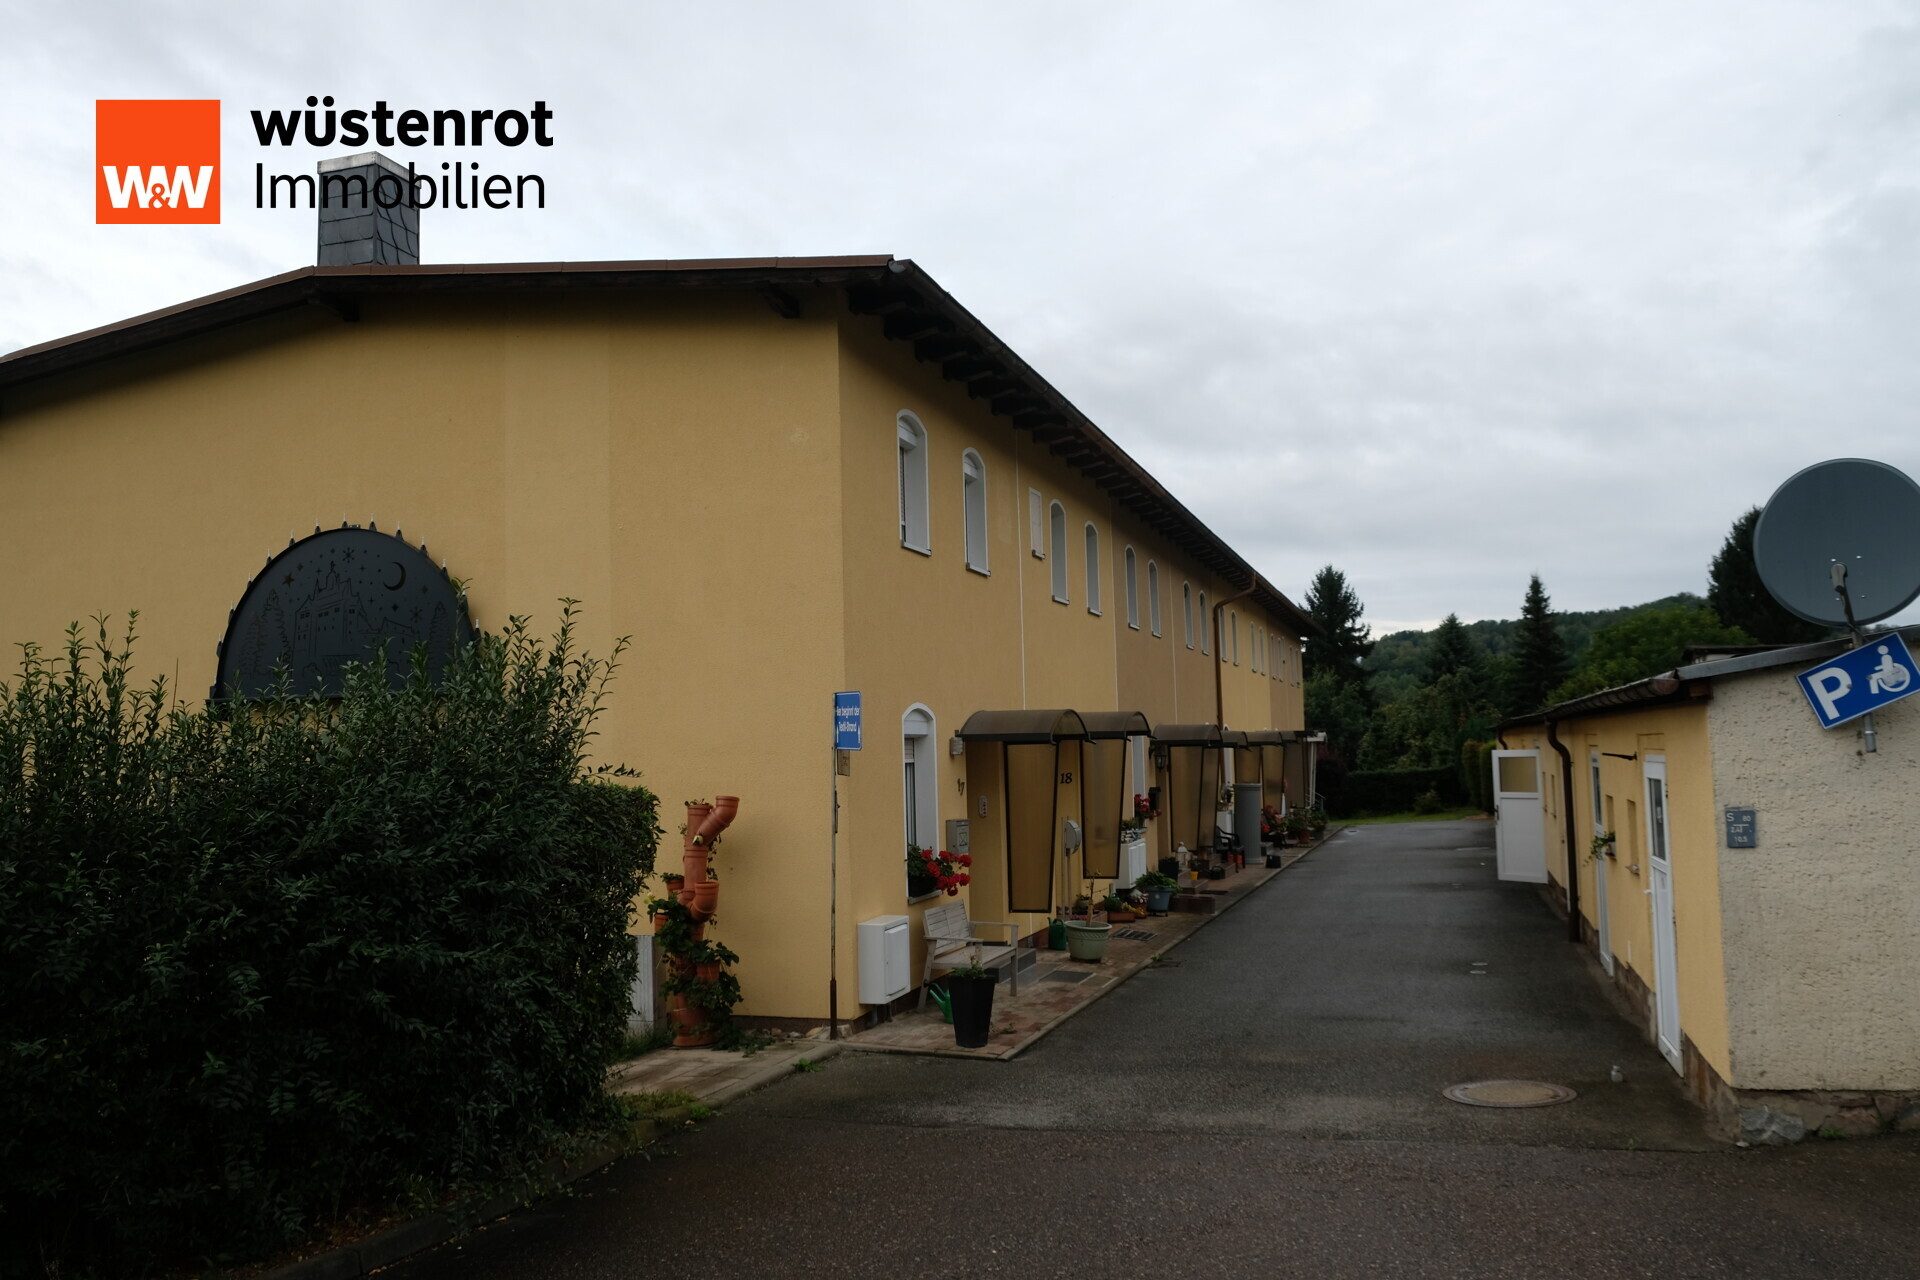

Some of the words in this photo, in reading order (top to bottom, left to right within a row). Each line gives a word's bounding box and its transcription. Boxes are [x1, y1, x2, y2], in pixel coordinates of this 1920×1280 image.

[1807, 667, 1852, 720] P
[1060, 772, 1073, 785] 18
[1726, 813, 1734, 822] S
